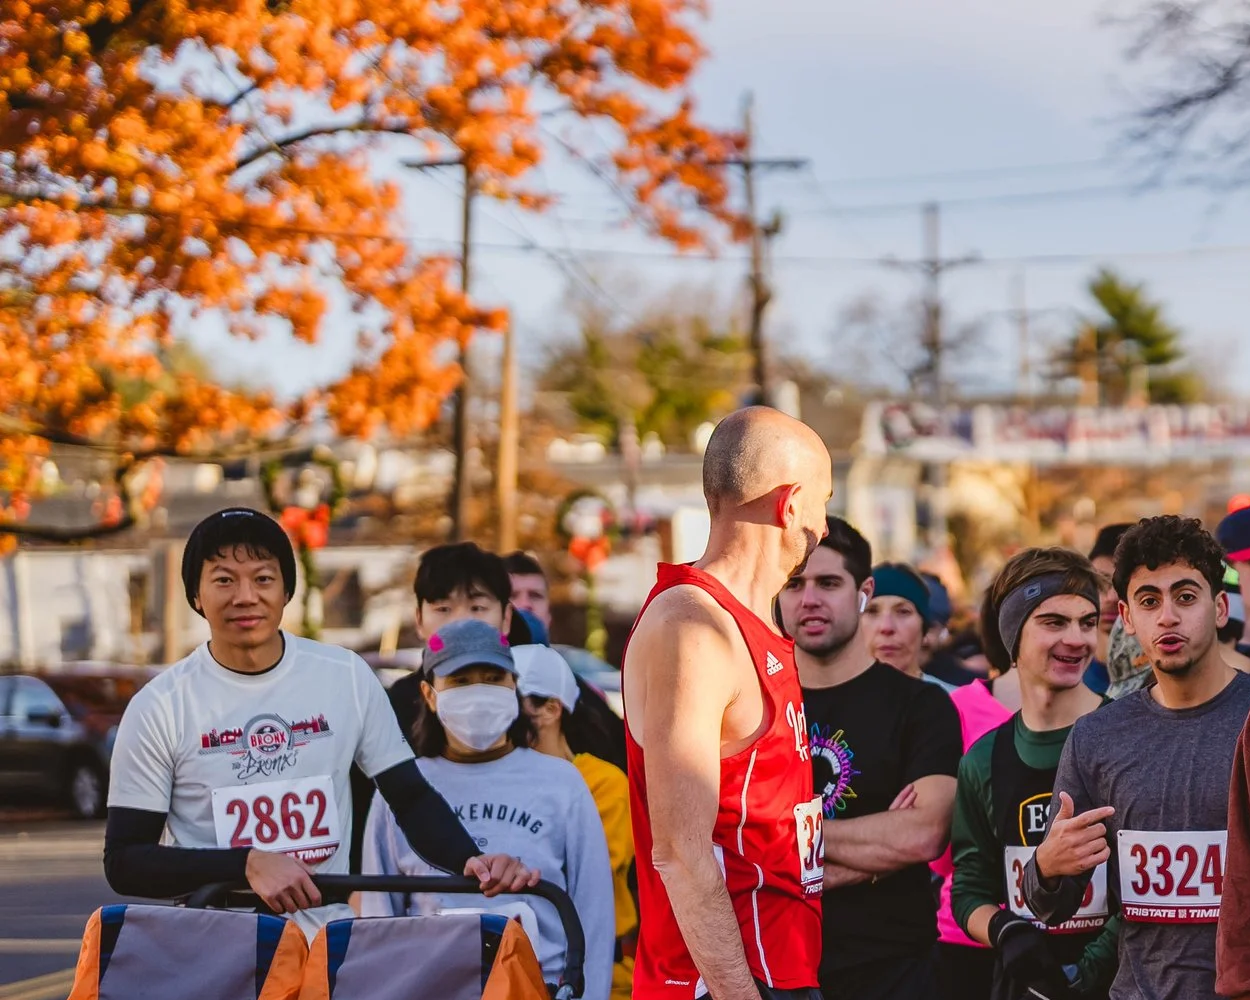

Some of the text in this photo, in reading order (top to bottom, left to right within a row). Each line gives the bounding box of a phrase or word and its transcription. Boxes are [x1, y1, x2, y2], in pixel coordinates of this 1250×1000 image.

[250, 731, 287, 748] BRONX
[226, 788, 330, 848] 2862
[1130, 844, 1223, 897] 3324
[1126, 907, 1175, 918] TRISTATE
[1060, 917, 1104, 929] TIMING
